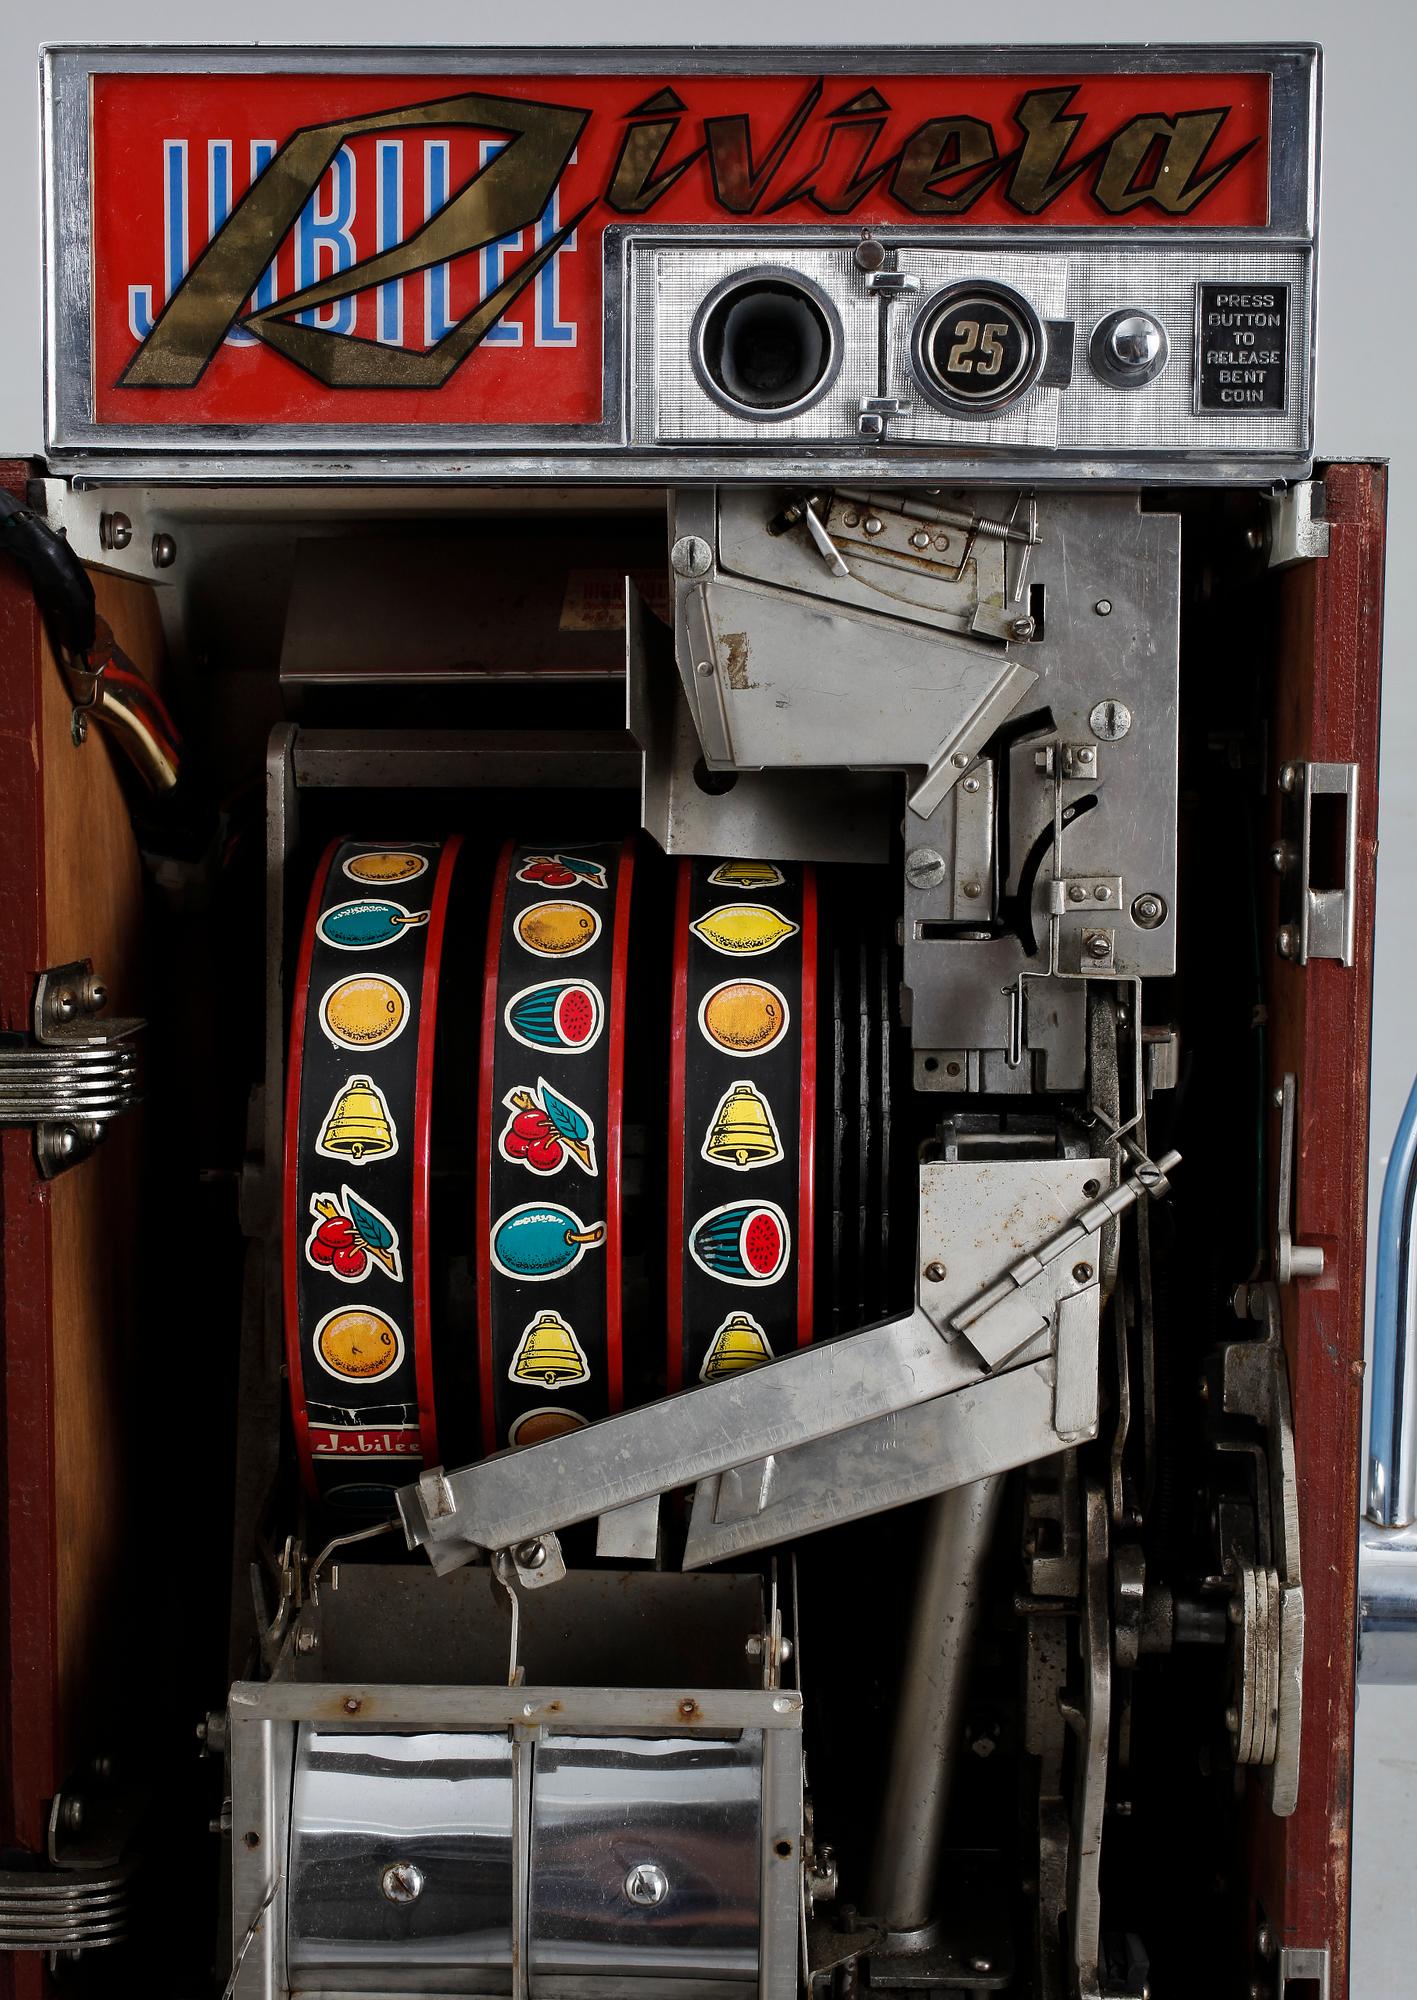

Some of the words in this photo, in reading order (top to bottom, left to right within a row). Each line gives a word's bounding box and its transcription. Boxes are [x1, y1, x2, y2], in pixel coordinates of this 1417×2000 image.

[127, 138, 578, 348] JUBILEE
[1216, 294, 1275, 308] PRESS
[1208, 313, 1281, 327] BUTTON
[1232, 331, 1255, 346] TO
[947, 320, 1009, 375] 25
[1206, 350, 1281, 365] RELEASE
[1219, 369, 1267, 384] BENT
[1220, 388, 1264, 403] COIN
[316, 1434, 420, 1453] Jubilee
